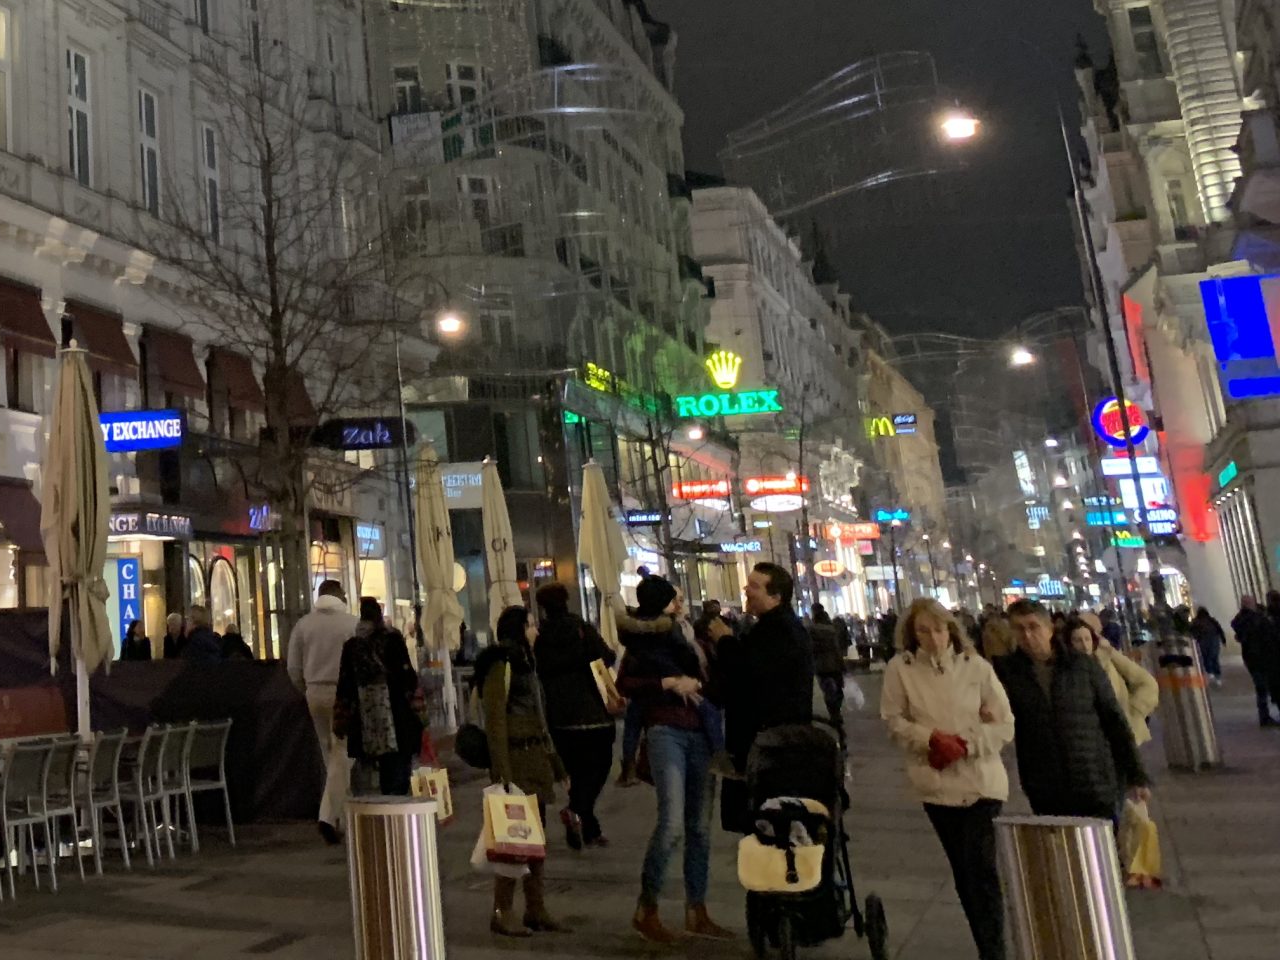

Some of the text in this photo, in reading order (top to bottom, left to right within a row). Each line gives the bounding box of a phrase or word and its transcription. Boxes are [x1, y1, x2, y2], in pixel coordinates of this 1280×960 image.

[676, 390, 783, 418] ROLEX
[112, 419, 182, 440] EXCHANGE
[720, 541, 762, 553] WAGNER
